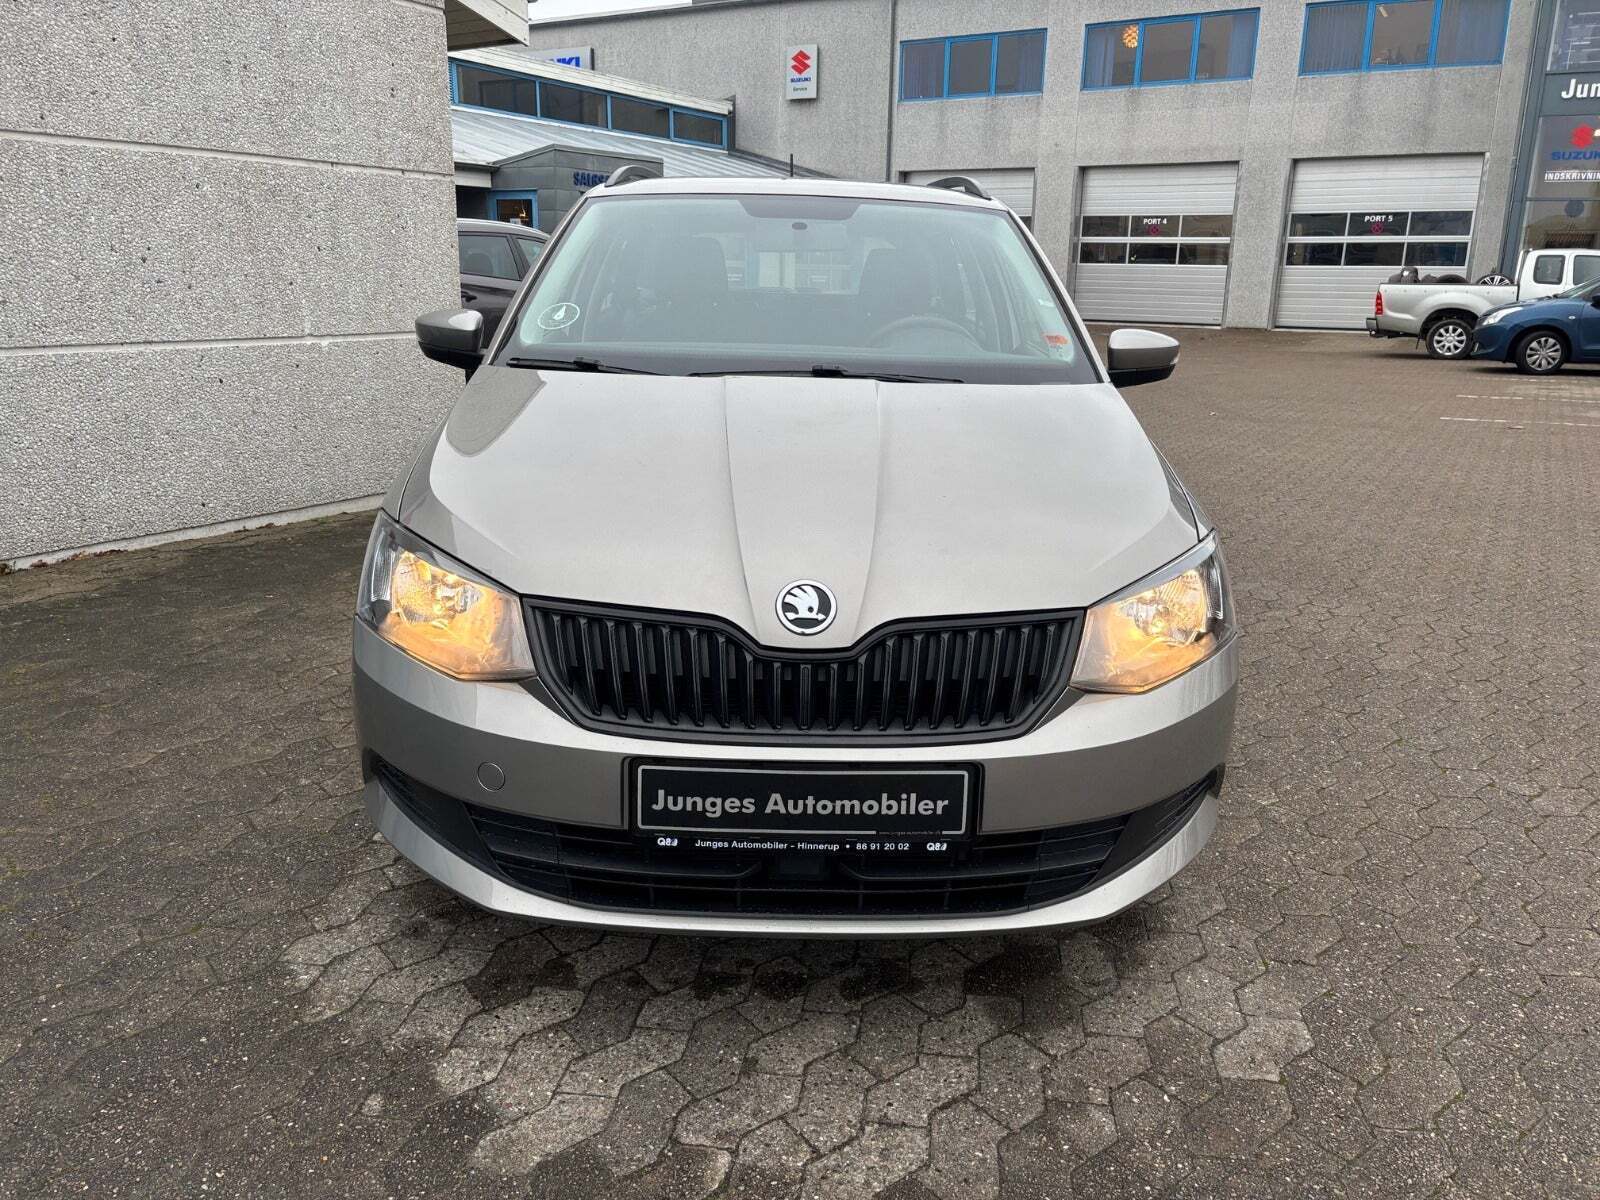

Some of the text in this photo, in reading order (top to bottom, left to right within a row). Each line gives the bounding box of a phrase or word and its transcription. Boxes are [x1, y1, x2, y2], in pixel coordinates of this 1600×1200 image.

[1388, 214, 1393, 222] 5
[652, 789, 949, 818] Junges Automobiler
[695, 839, 729, 849] Junges
[731, 840, 788, 849] Automobiler
[797, 842, 840, 851] Hinnerup
